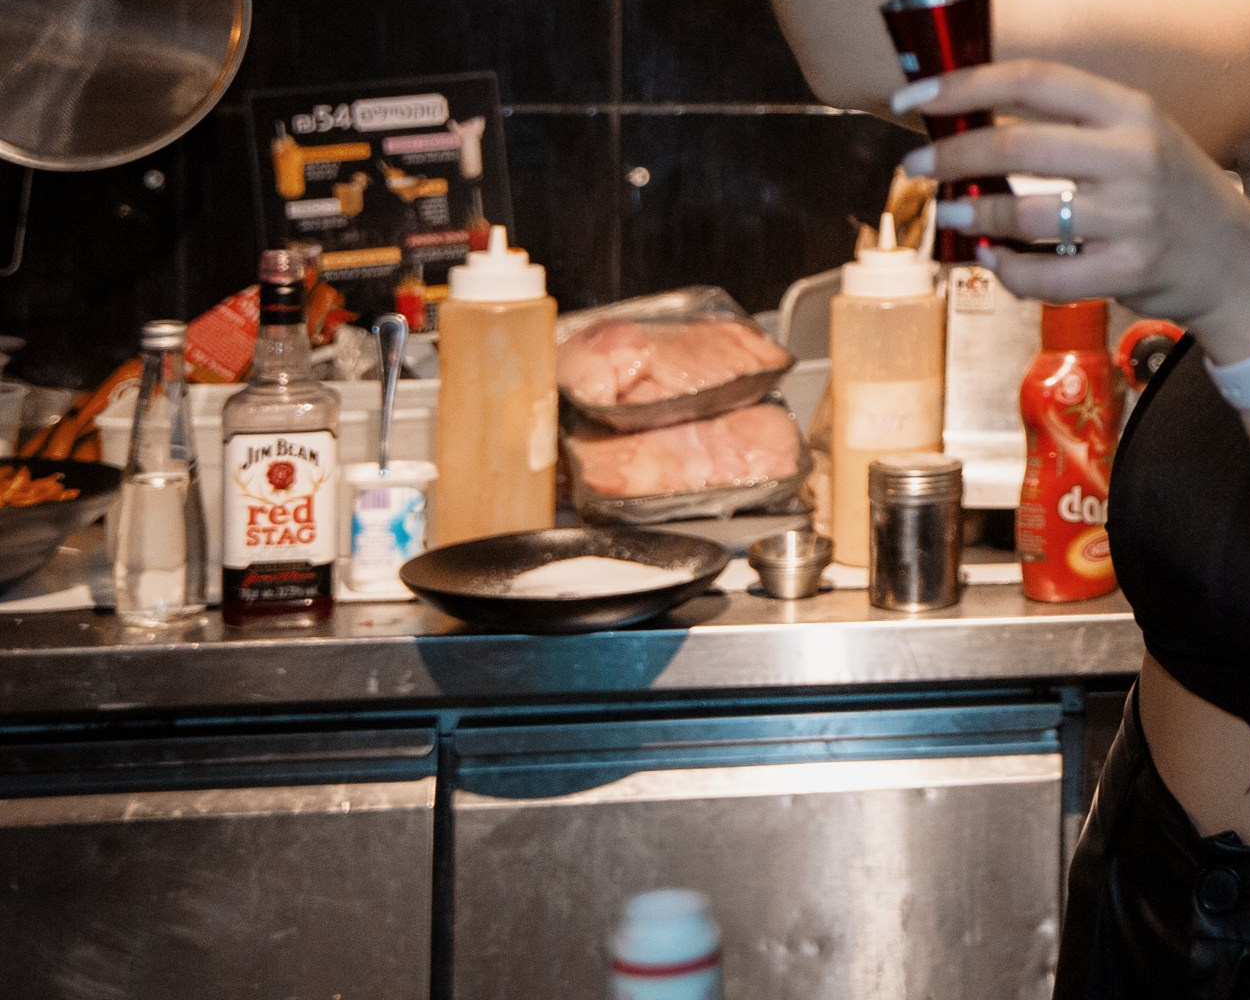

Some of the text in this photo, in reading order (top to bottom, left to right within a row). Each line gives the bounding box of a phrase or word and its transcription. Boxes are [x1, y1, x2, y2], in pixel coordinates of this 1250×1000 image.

[242, 438, 320, 470] JIM BEAM
[247, 495, 314, 526] red
[245, 525, 318, 547] STAG
